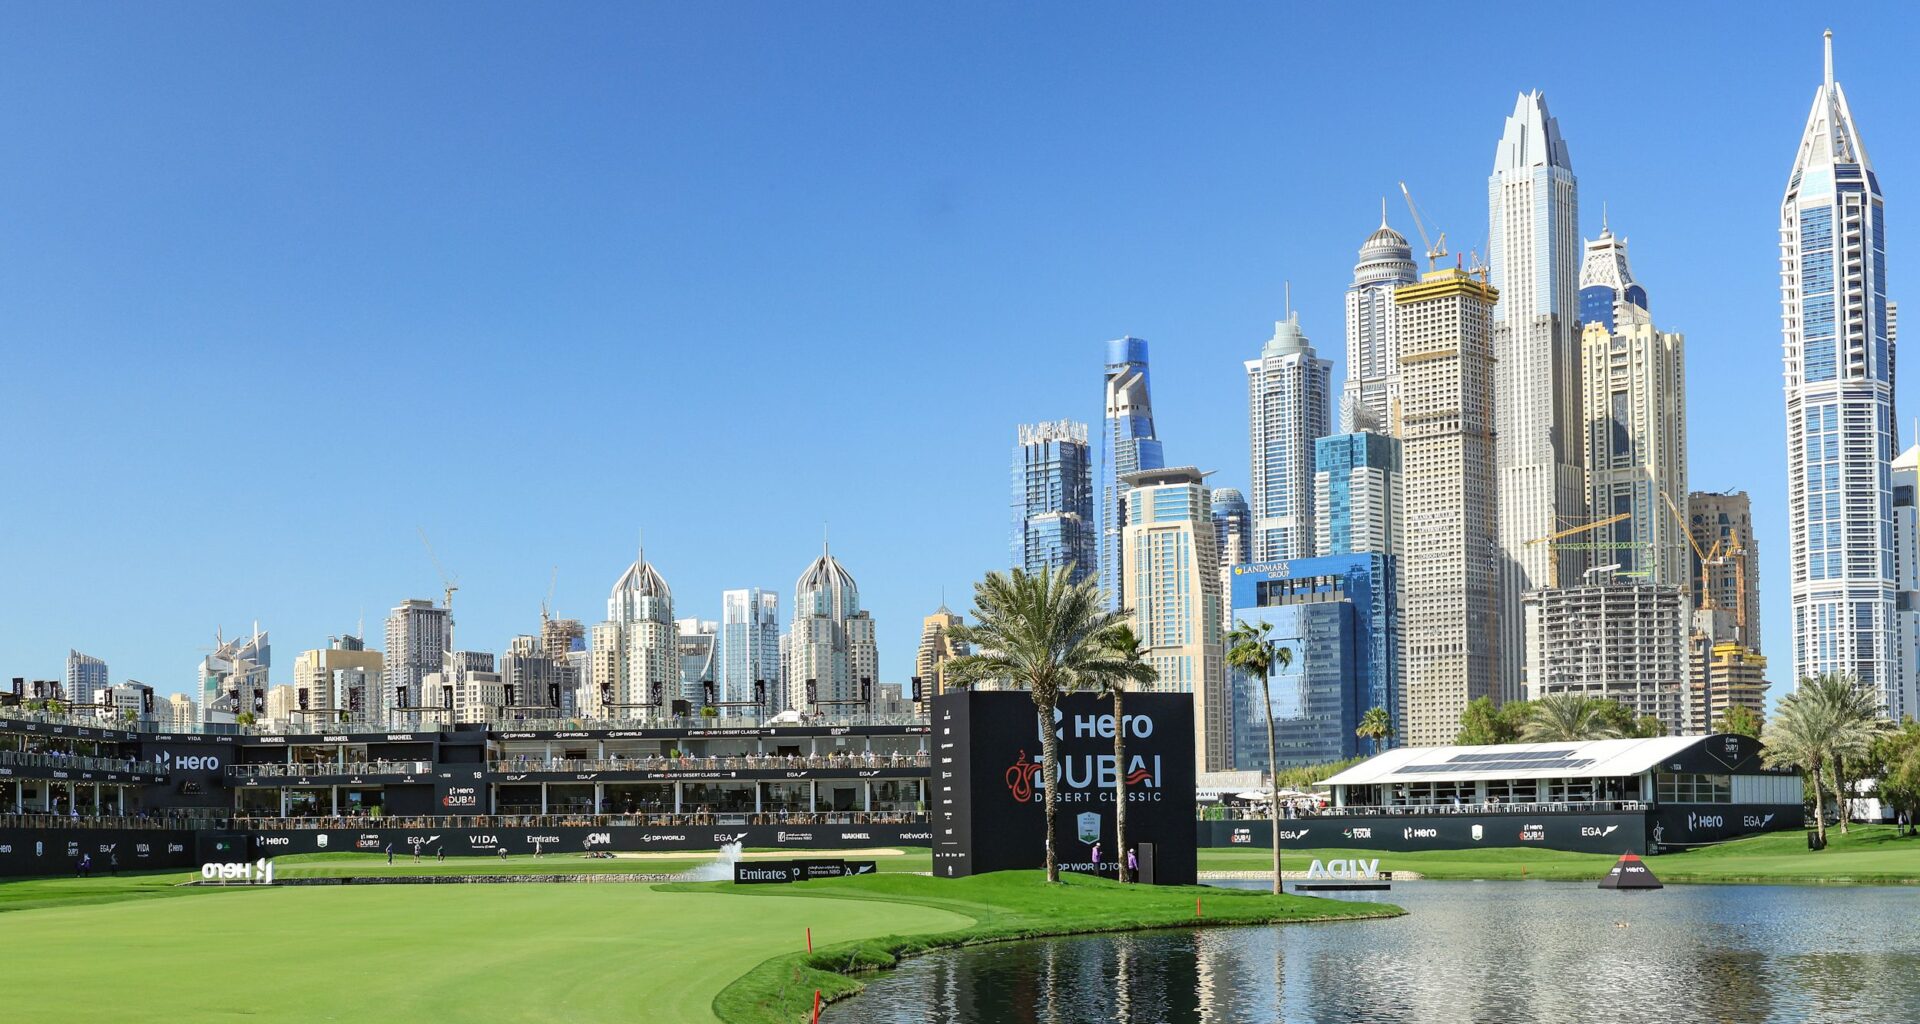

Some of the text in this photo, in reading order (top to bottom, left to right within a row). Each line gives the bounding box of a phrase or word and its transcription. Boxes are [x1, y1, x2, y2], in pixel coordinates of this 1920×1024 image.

[1243, 562, 1289, 574] LANDMARK
[1268, 570, 1290, 578] GROUP
[466, 655, 492, 668] EMAAR
[1075, 714, 1153, 738] Hero
[176, 756, 219, 770] Hero
[1034, 792, 1161, 802] DSERT CLSSIC
[1699, 816, 1722, 827] Hero
[1743, 816, 1760, 827] EGA
[1280, 831, 1296, 839] EGA
[1414, 829, 1436, 837] Hero
[1582, 827, 1601, 836] EGA
[469, 836, 498, 844] VIDA
[589, 833, 610, 844] CNN
[100, 844, 109, 852] EGA
[136, 844, 149, 852] VIDA
[172, 844, 183, 852] Hero
[740, 869, 786, 879] Emirates
